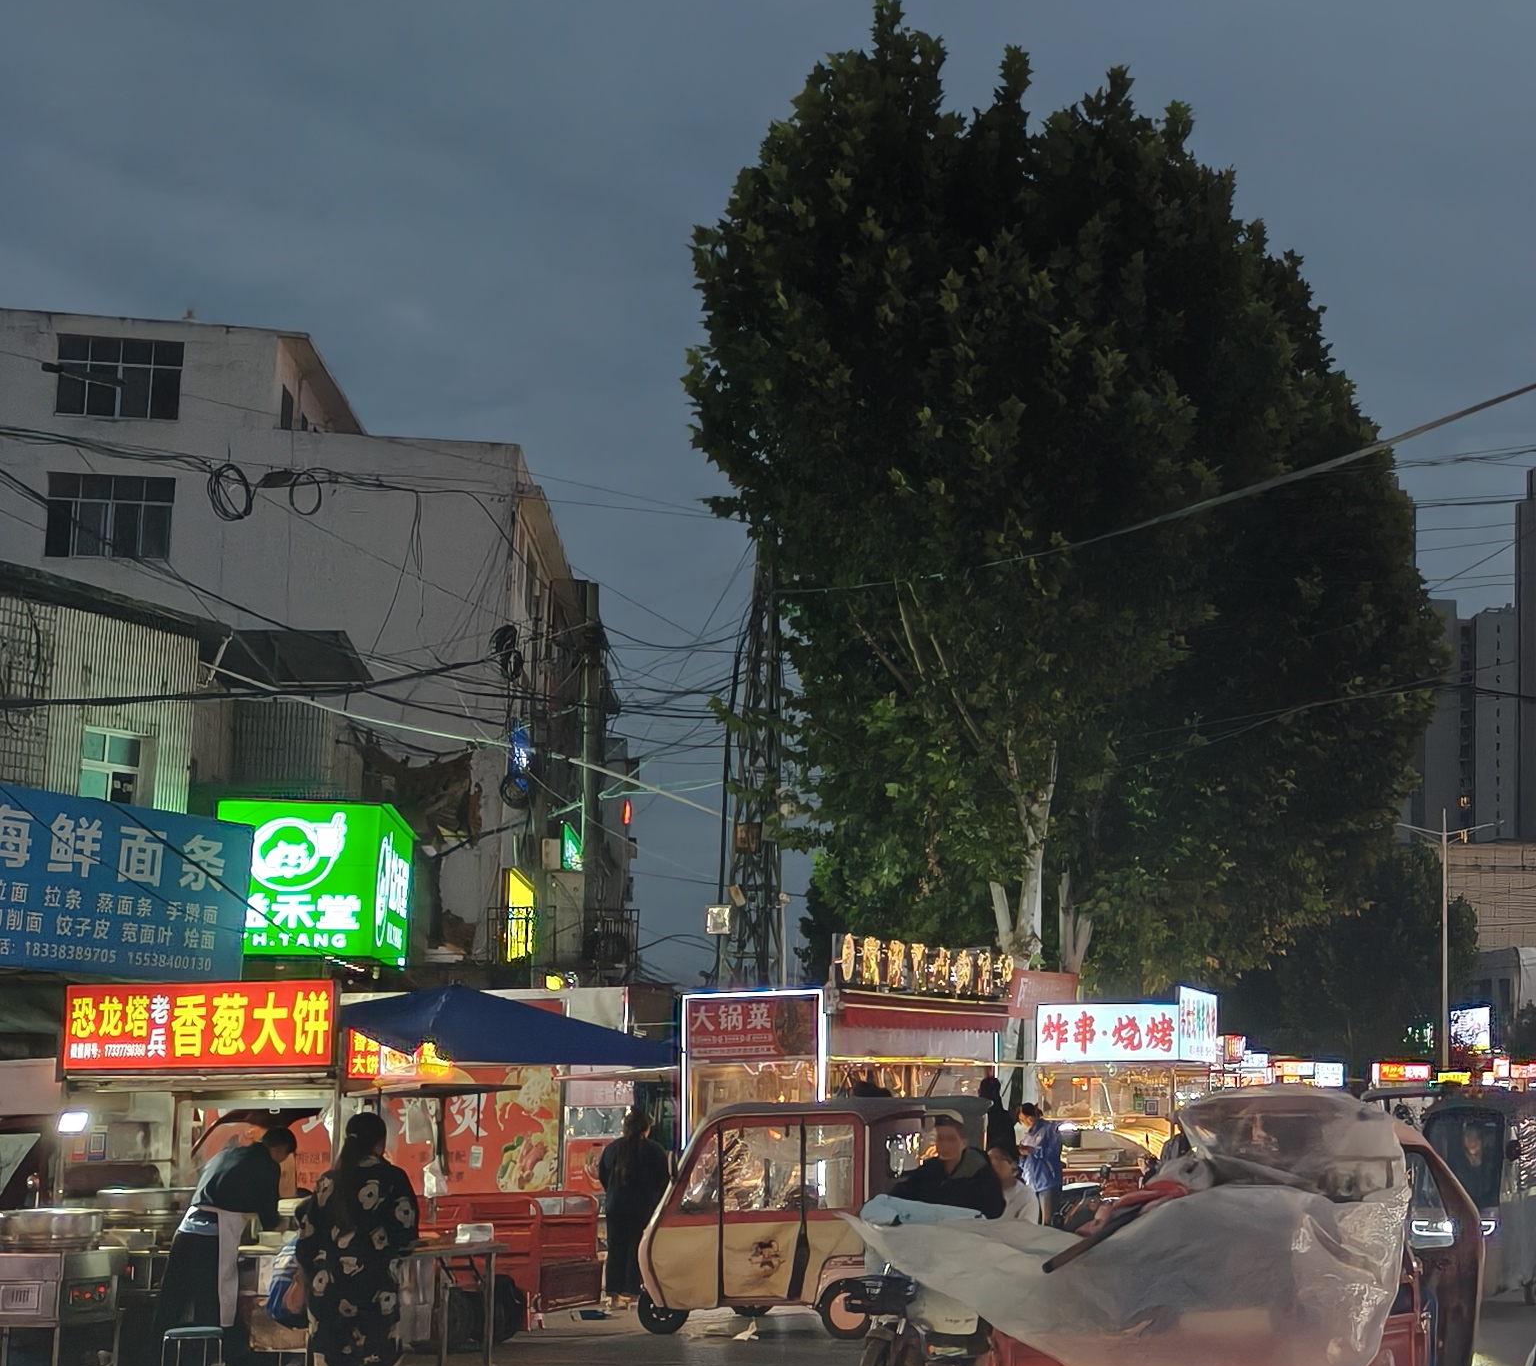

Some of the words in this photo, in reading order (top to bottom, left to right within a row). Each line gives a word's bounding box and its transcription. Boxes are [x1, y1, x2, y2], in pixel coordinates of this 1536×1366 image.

[0, 804, 226, 892] 海鲜面条
[0, 908, 43, 933] 削面
[56, 913, 110, 939] 饺子皮
[243, 932, 347, 948] H.TANG
[71, 995, 149, 1038] 恐龙塔
[148, 995, 170, 1058] 老兵
[172, 990, 329, 1057] 香葱大饼
[691, 1003, 772, 1032] 大锅菜
